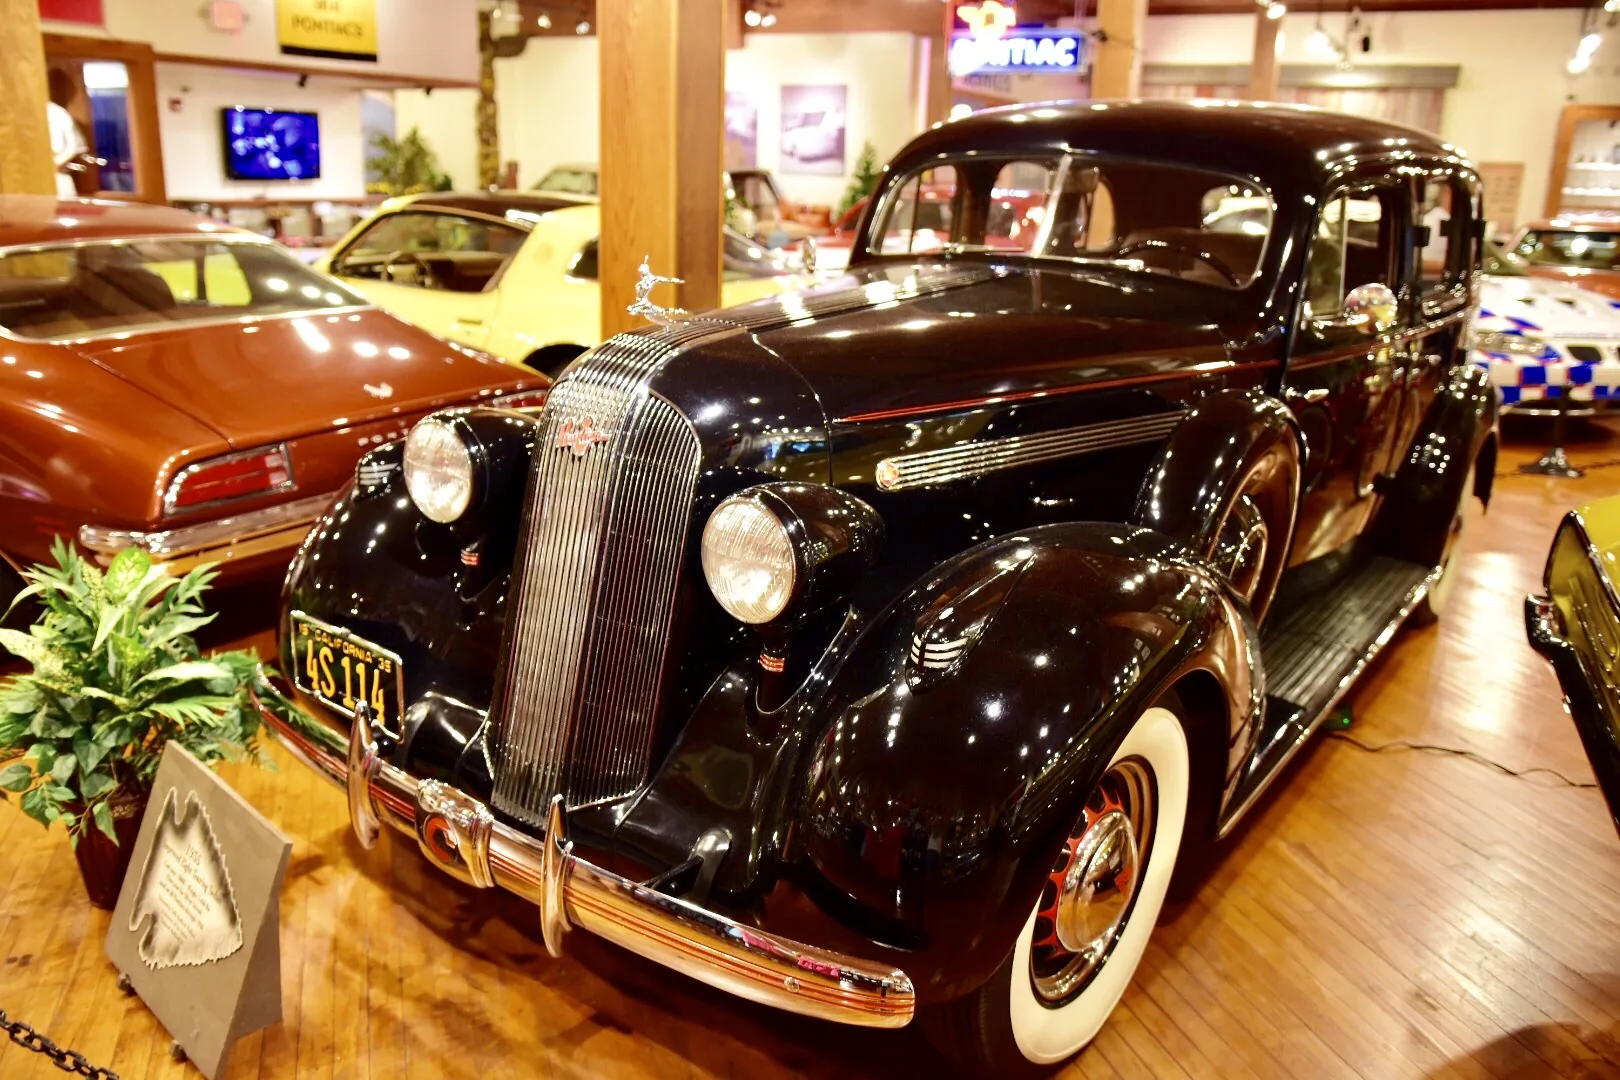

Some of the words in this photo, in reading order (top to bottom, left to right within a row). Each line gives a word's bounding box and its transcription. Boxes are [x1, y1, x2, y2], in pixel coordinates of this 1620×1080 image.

[951, 37, 1077, 67] PNTIAC
[315, 629, 373, 664] CALIFORNIA
[306, 639, 335, 698] 4S
[341, 656, 385, 726] 114
